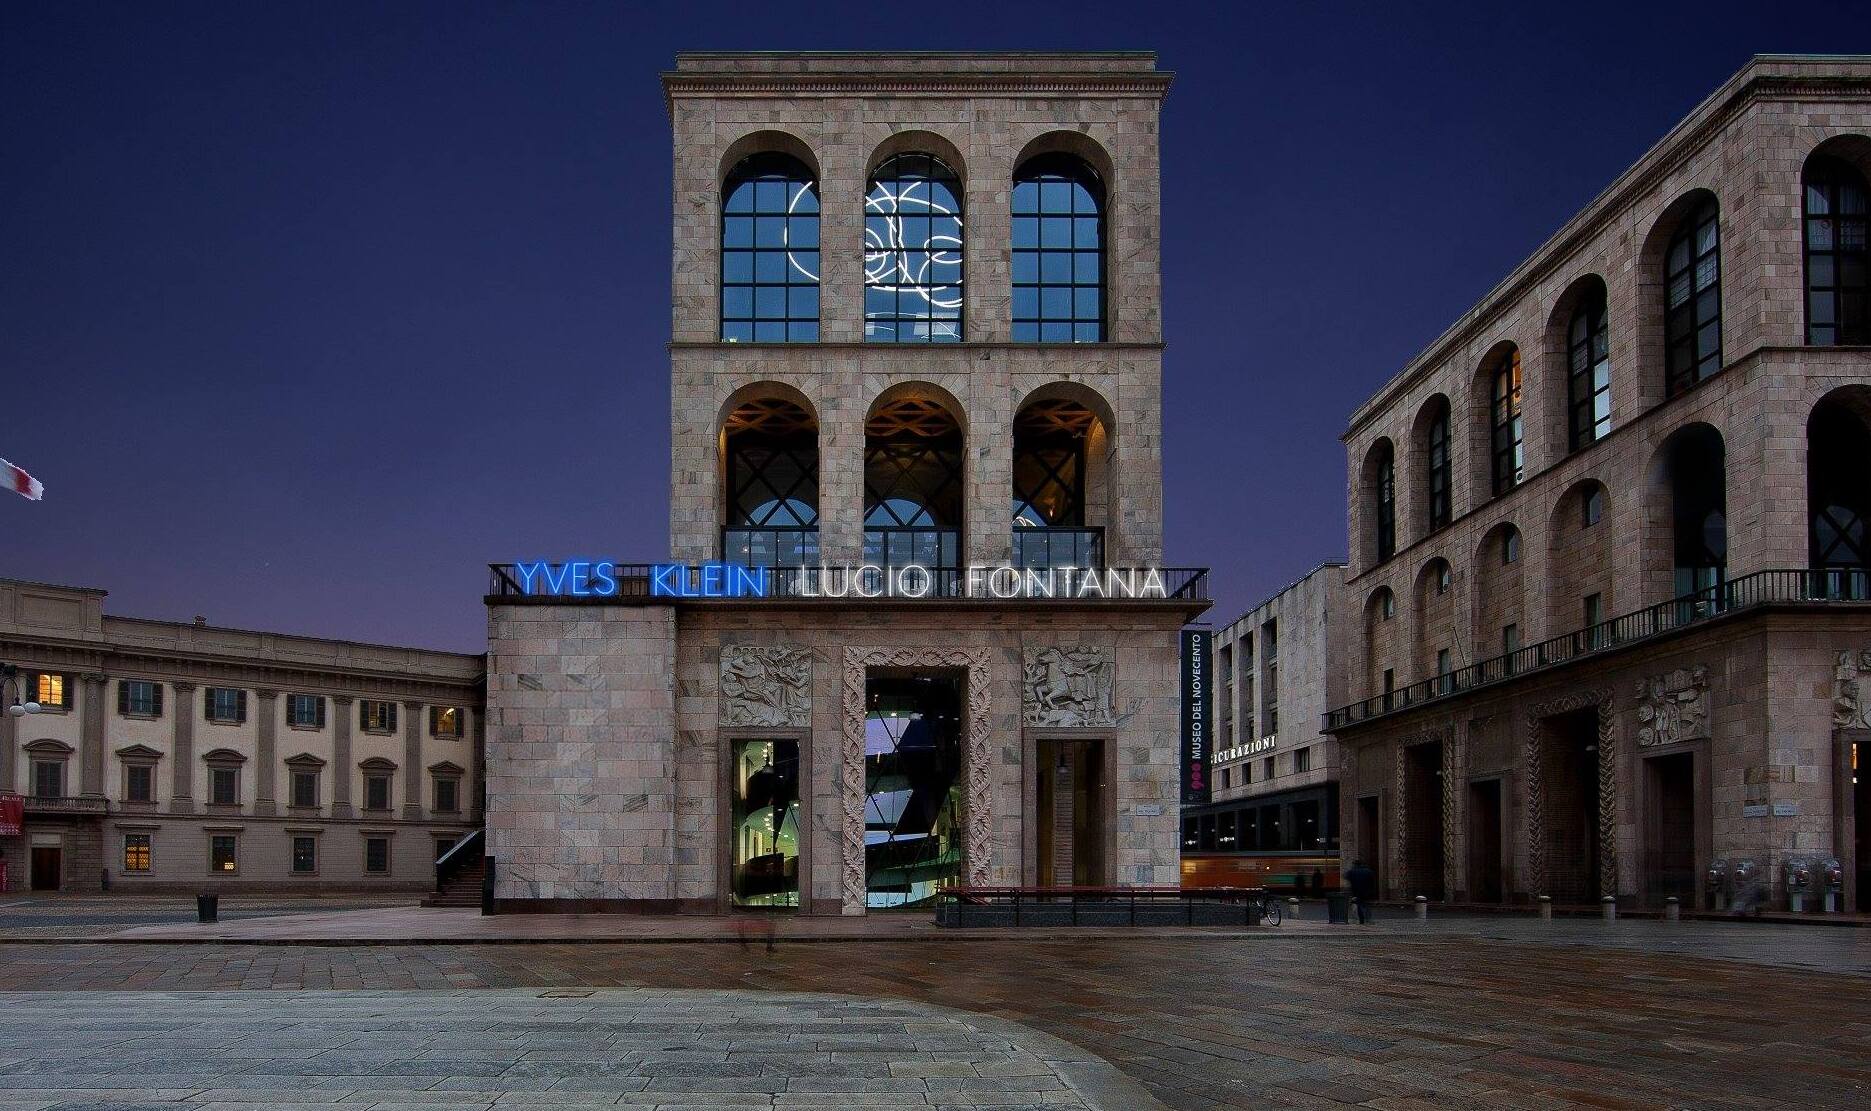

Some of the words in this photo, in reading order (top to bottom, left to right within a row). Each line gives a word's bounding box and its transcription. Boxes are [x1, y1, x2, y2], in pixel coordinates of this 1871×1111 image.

[516, 562, 616, 597] YVES
[652, 564, 765, 598] KLEIN
[800, 564, 931, 599] LUCIO
[967, 565, 1168, 599] FONTANA
[1191, 634, 1202, 698] NOVECENTO
[1191, 701, 1202, 720] DEL
[1191, 722, 1202, 759] MUSEO
